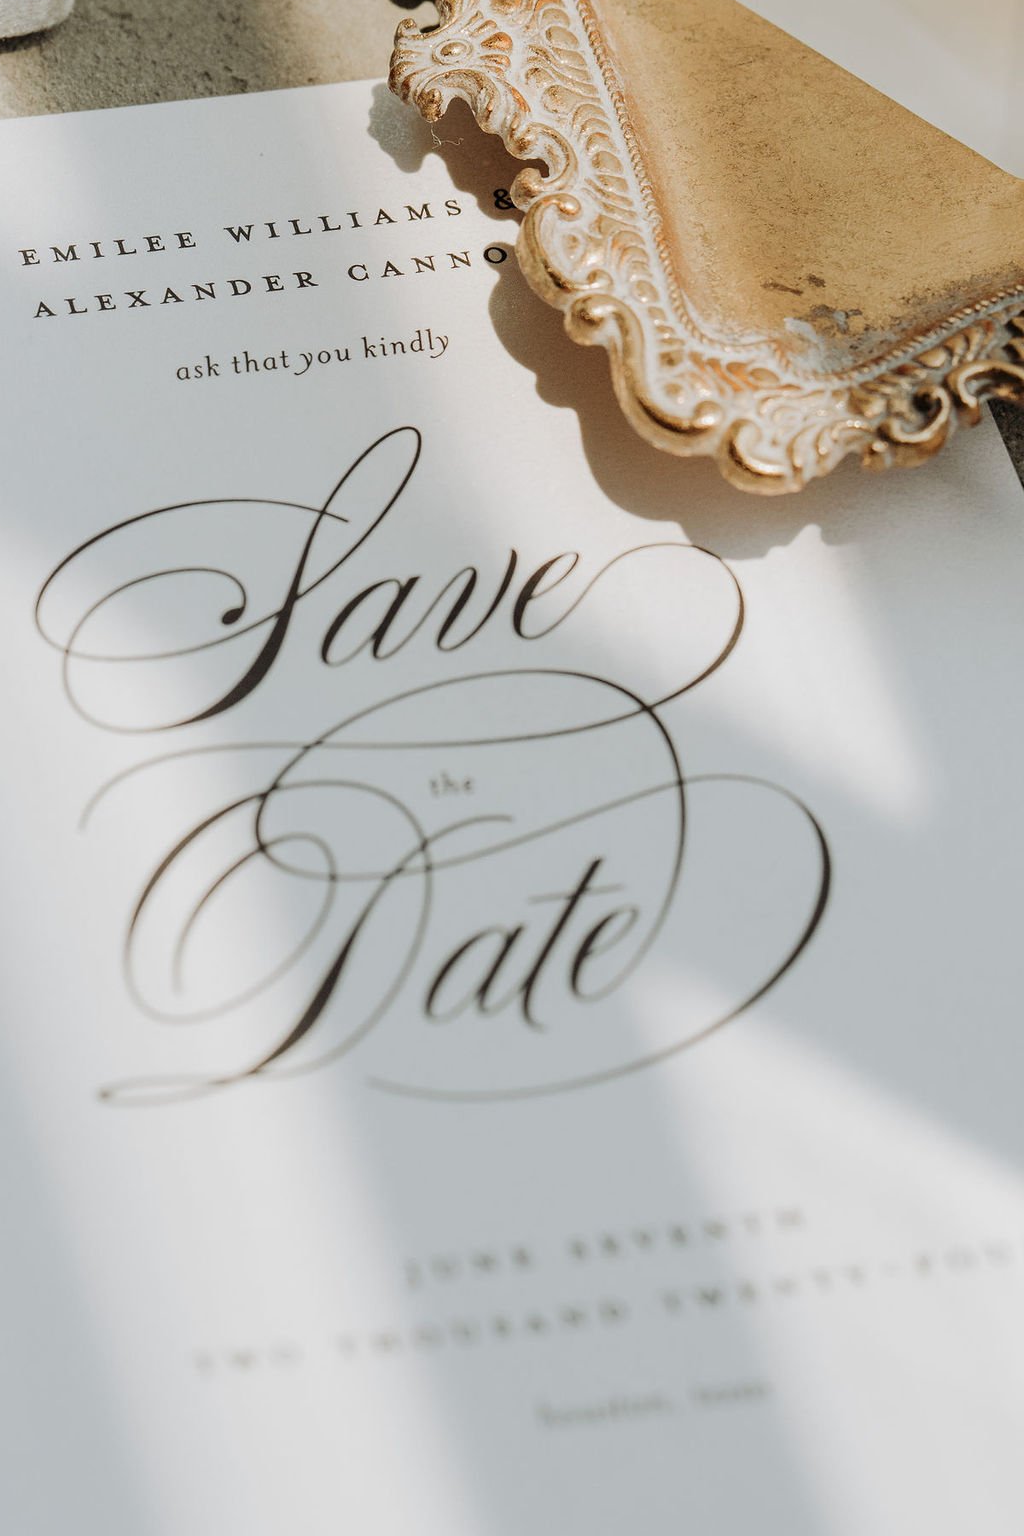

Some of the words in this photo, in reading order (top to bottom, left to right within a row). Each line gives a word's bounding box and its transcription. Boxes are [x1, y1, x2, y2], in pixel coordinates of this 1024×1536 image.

[18, 231, 197, 267] EMILEE
[223, 198, 464, 244] WILLIAMS
[493, 188, 517, 210] &
[33, 271, 320, 319] ALEXANDER
[347, 246, 508, 283] CANNO
[176, 356, 221, 381] ask
[232, 350, 290, 374] that
[293, 344, 351, 376] you
[361, 328, 450, 360] kindly
[34, 426, 746, 831] Save
[429, 769, 475, 799] the
[97, 670, 832, 1107] Date
